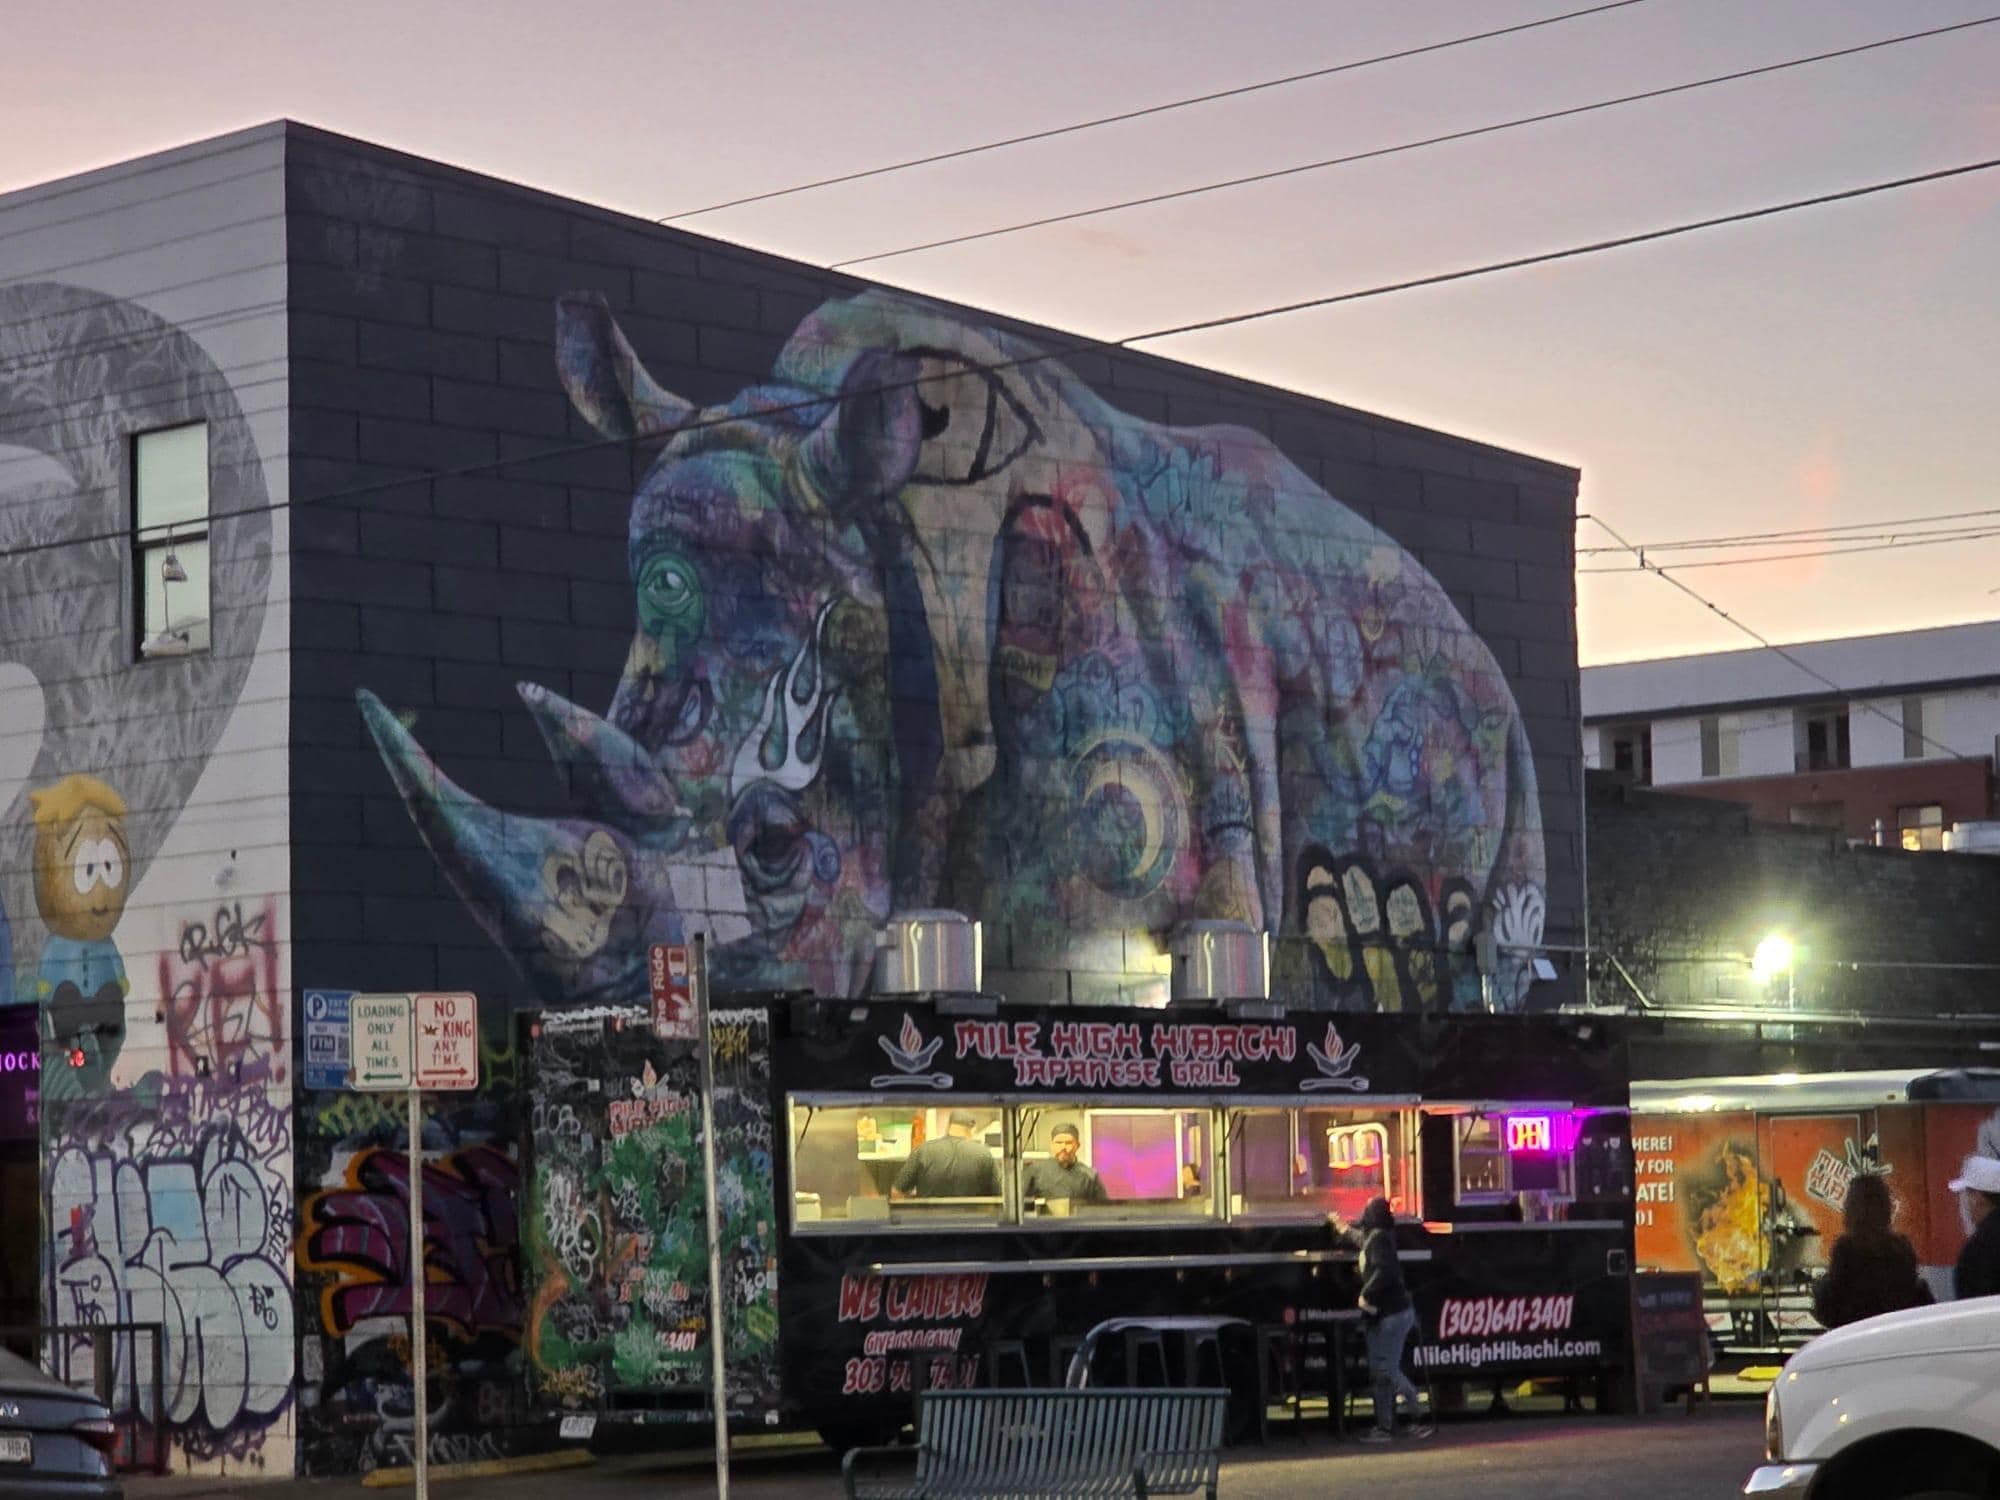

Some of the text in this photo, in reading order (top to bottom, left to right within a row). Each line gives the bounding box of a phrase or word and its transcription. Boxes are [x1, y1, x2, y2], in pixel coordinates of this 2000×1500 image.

[653, 947, 665, 991] Ride
[358, 1005, 405, 1018] LOADING
[434, 1001, 456, 1017] NO
[367, 1023, 394, 1035] ONLY
[443, 1021, 471, 1038] KING
[371, 1040, 390, 1051] ALL
[434, 1040, 457, 1051] ANY
[954, 1020, 1297, 1062] MILE HIGH HIBACHI
[0, 1051, 41, 1072] OCK
[366, 1056, 399, 1068] TIMES
[1014, 1057, 1240, 1087] JAPANESE GRILL
[1511, 1120, 1547, 1149] OPEN
[1648, 1159, 1674, 1174] FOR
[839, 1273, 988, 1322] WE CATER!
[1439, 1296, 1574, 1340] (303)641-3401
